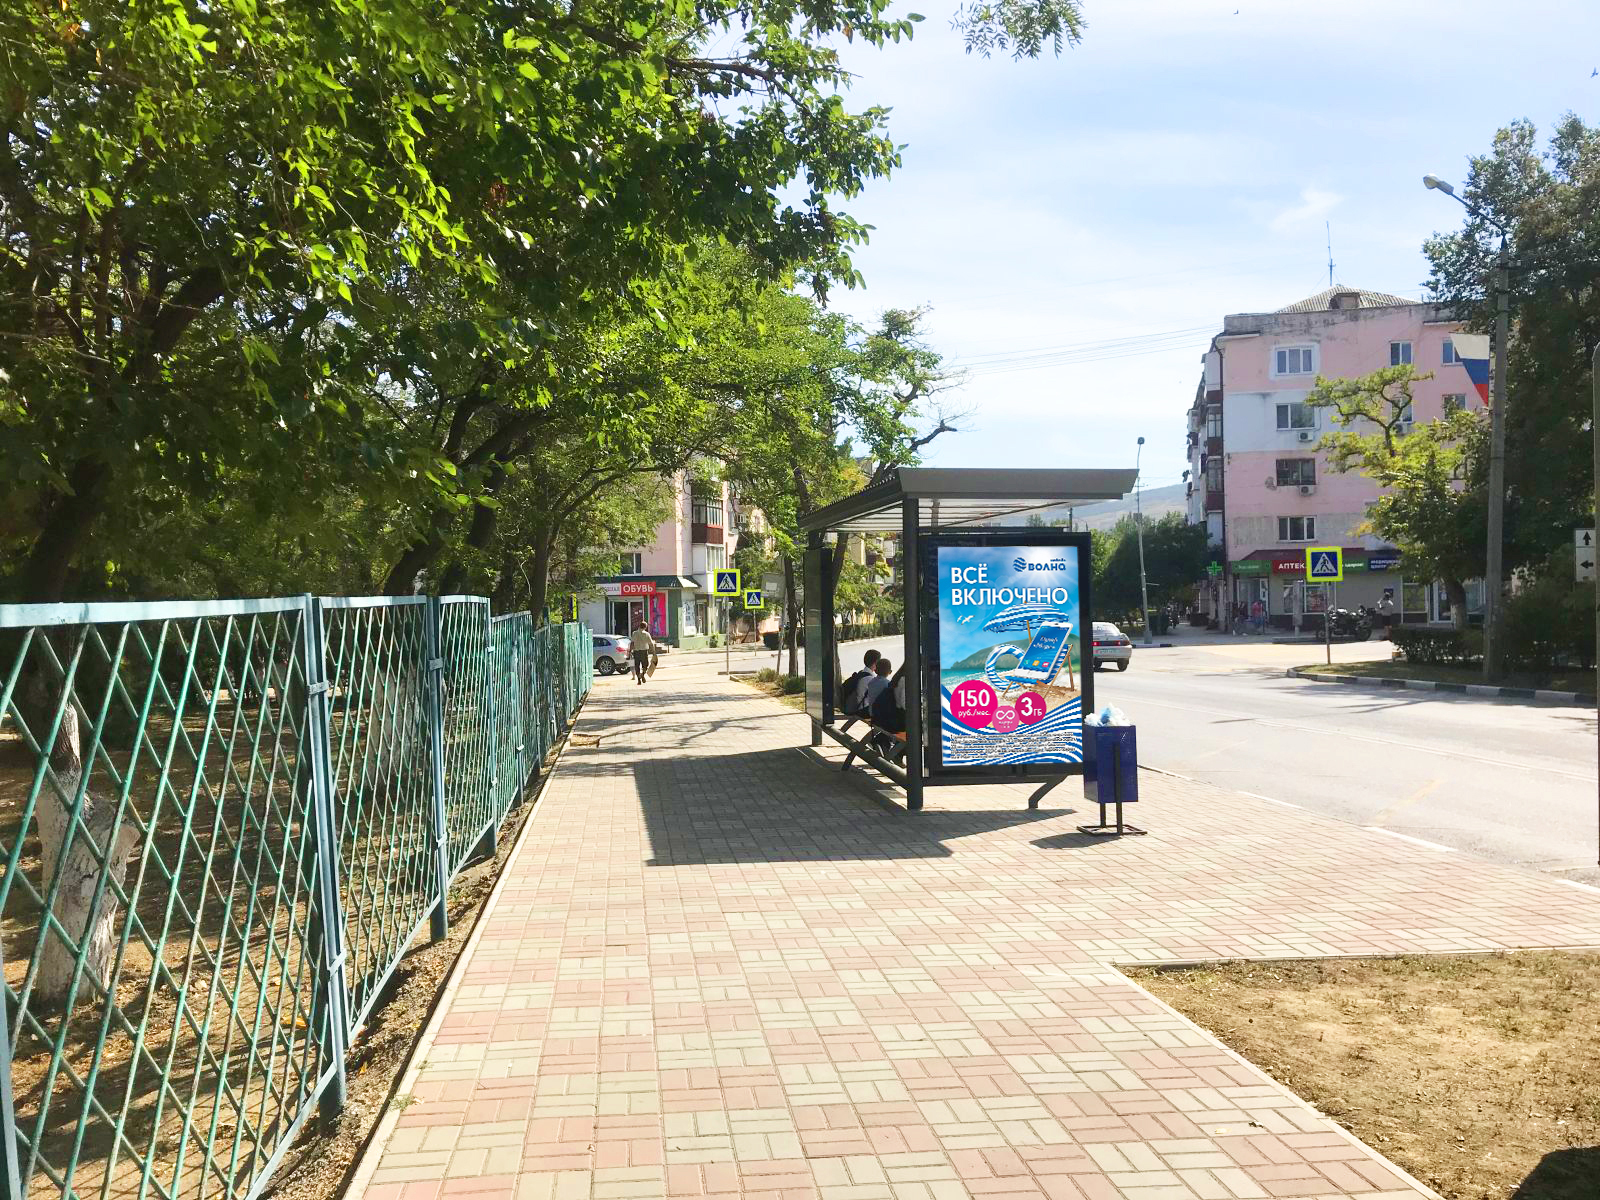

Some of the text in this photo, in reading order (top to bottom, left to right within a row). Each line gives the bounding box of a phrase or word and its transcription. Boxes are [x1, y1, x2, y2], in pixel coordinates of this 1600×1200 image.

[951, 563, 988, 584] ВСЁ
[623, 584, 653, 593] ОБУВЬ
[951, 587, 1069, 605] ВКЛЮЧЕНО
[958, 688, 990, 708] 150
[1021, 696, 1042, 716] 3 ГБ
[958, 709, 991, 718] руб./мес.
